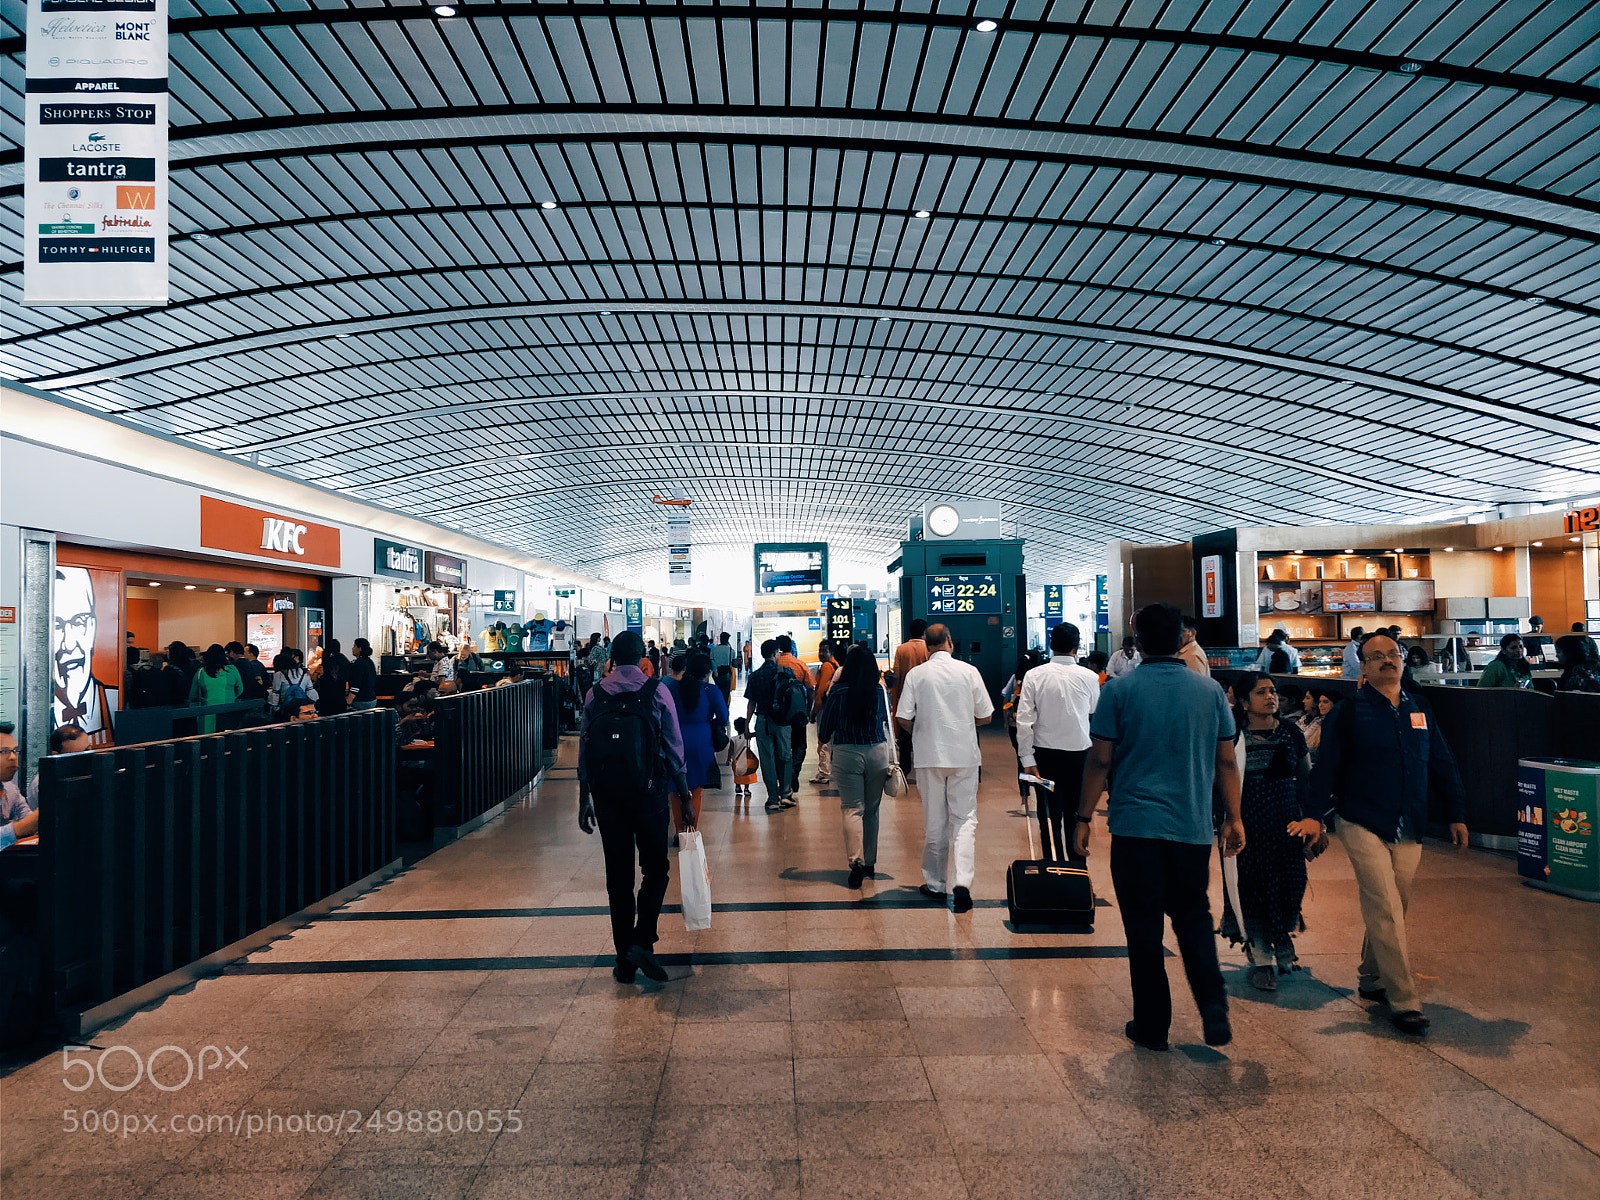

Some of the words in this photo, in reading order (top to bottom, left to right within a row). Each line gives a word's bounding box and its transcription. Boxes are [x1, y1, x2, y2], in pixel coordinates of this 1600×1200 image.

[115, 22, 150, 32] MONT
[115, 32, 151, 41] BLANC
[75, 82, 120, 91] APPAREL
[44, 106, 111, 119] SHOPPERS
[116, 106, 153, 119] STOP
[72, 143, 121, 152] LACOSTE
[67, 162, 127, 176] tantra
[125, 191, 151, 210] W
[101, 214, 153, 232] fabindia
[43, 246, 86, 254] TOMMY
[102, 246, 152, 254] HILFIGER
[1563, 504, 1600, 534] ne
[260, 517, 307, 555] KFC
[387, 547, 419, 574] tantra
[956, 583, 997, 597] 22-24
[956, 599, 975, 611] 26
[831, 614, 850, 624] 101
[832, 629, 851, 639] 112
